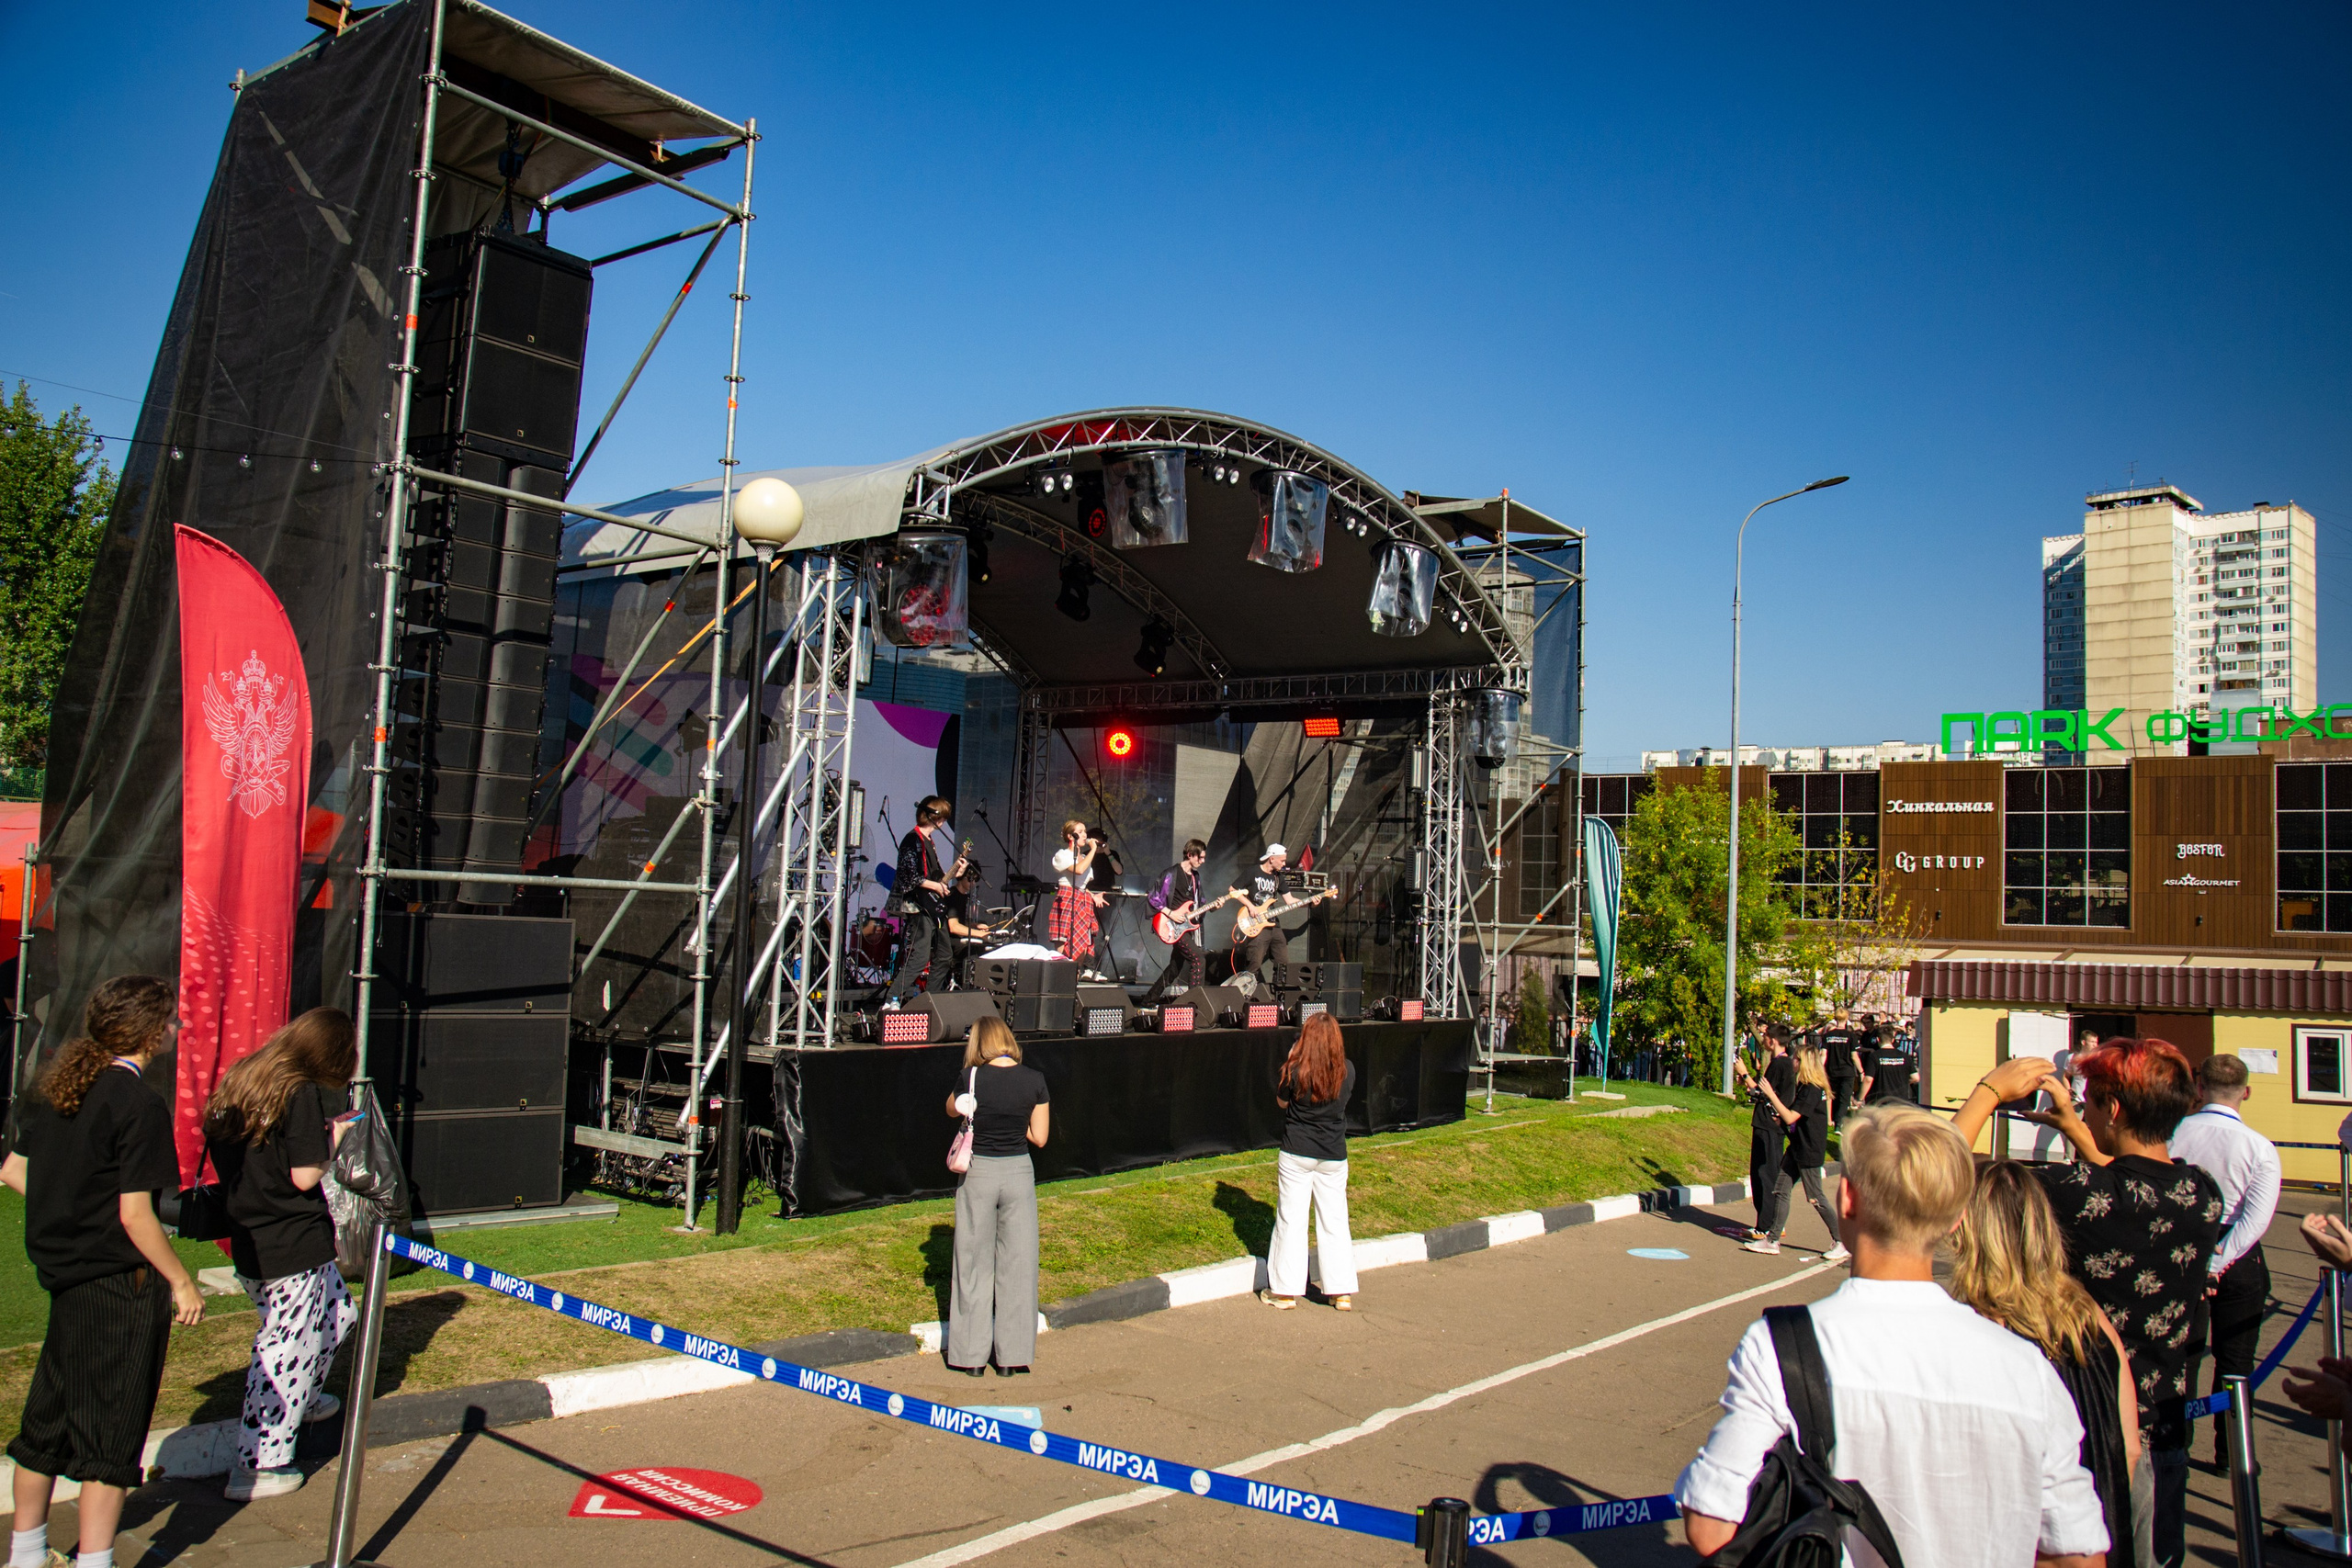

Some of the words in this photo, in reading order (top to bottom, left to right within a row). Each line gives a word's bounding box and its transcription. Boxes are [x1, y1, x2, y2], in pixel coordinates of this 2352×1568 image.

[1886, 799, 1995, 813] Хинкальная
[1923, 854, 1984, 869] GROUP
[2177, 843, 2225, 859] BOSFOR
[408, 1241, 449, 1271] МИРЭА
[489, 1270, 535, 1303] МИРЭА
[581, 1302, 631, 1335] МИРЭА
[684, 1334, 740, 1369] МИРЭА
[798, 1368, 862, 1405] МИРЭА
[930, 1404, 1001, 1443] МИРЭА
[2186, 1399, 2207, 1419] РЭА
[1078, 1442, 1159, 1483] МИРЭА
[611, 1473, 723, 1517] ПРИЕМНАЯ
[636, 1470, 748, 1511] КОМИССИЯ
[1247, 1482, 1340, 1525] МИРЭА
[1581, 1498, 1652, 1530] МИРЭА
